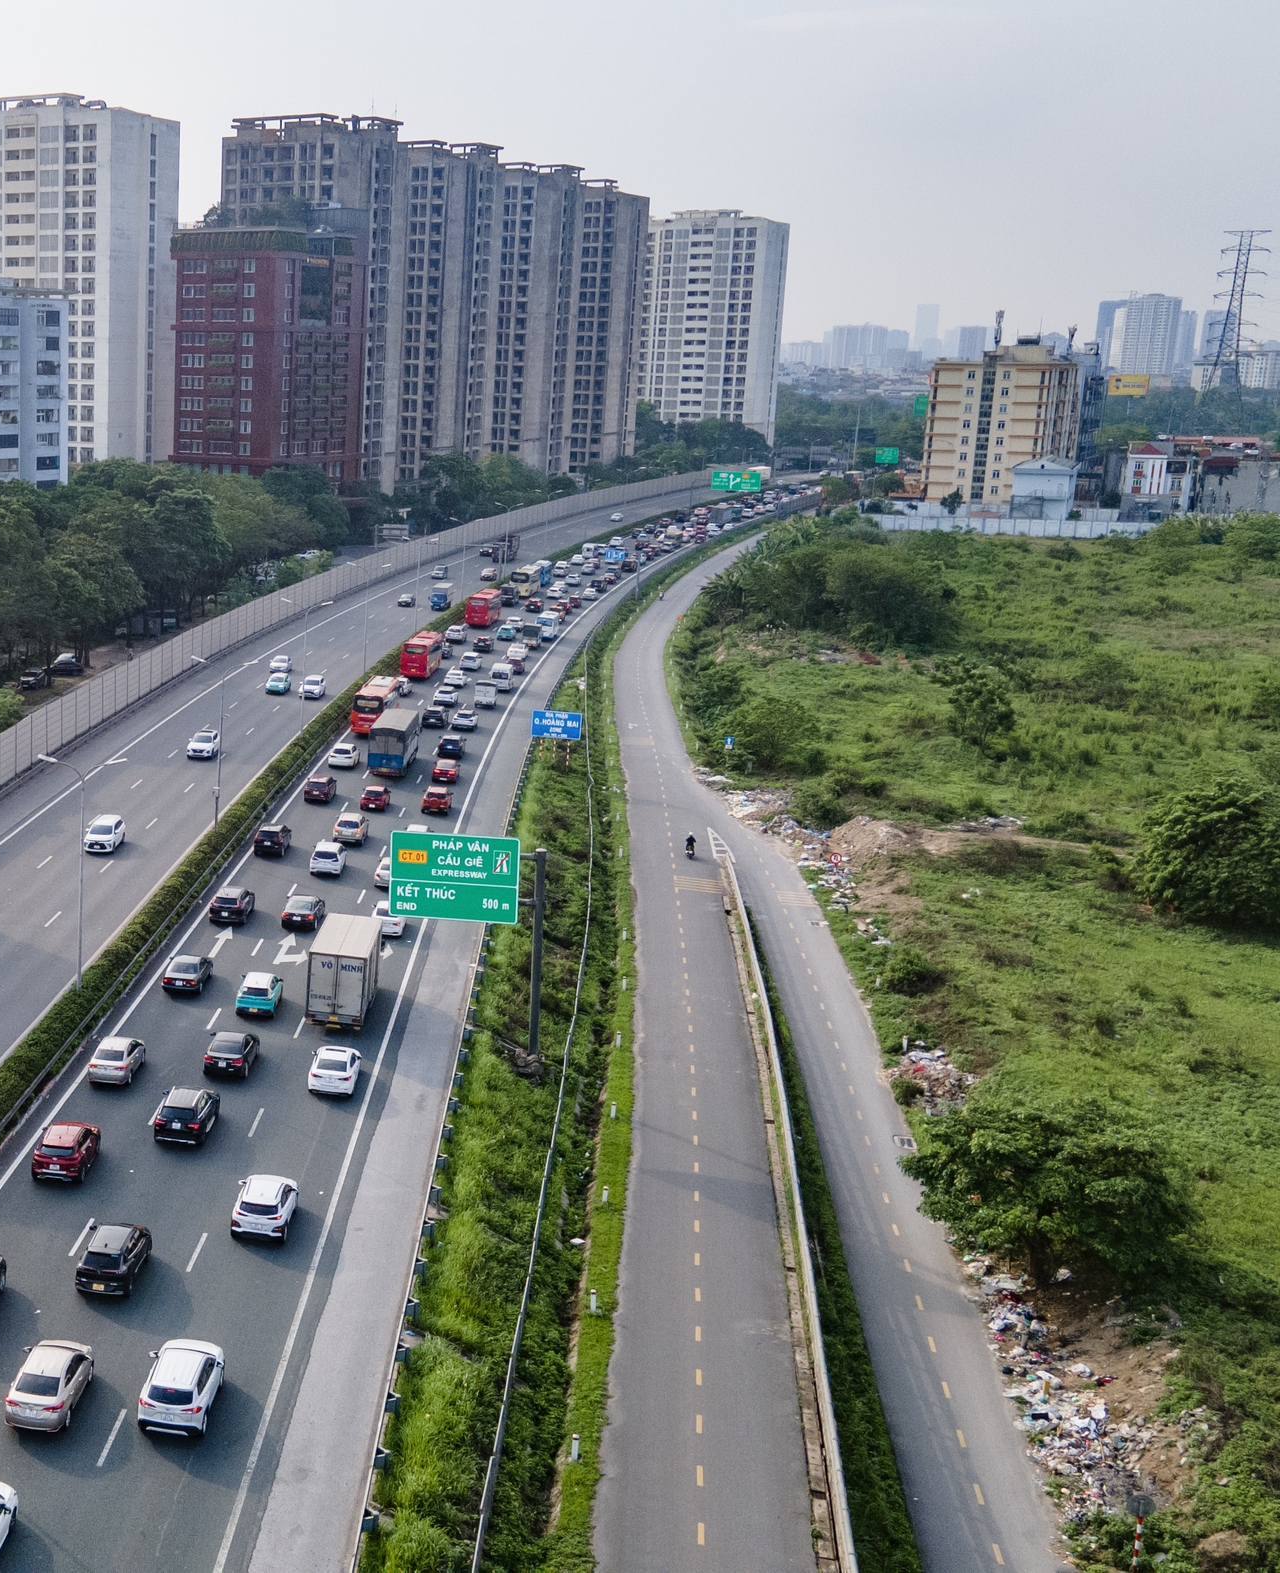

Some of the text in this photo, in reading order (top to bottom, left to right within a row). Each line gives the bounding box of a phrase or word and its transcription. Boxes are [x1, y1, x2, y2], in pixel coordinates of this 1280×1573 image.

[567, 720, 579, 728] MAI
[432, 838, 489, 853] PHÁP VÂN
[401, 852, 425, 861] CT.01
[437, 853, 483, 868] CẦU GIẼ
[432, 869, 487, 878] EXPRESSWAY
[396, 883, 456, 900] KẾT THÚC
[396, 901, 417, 911] END
[482, 898, 499, 910] 500
[340, 964, 363, 973] MINH
